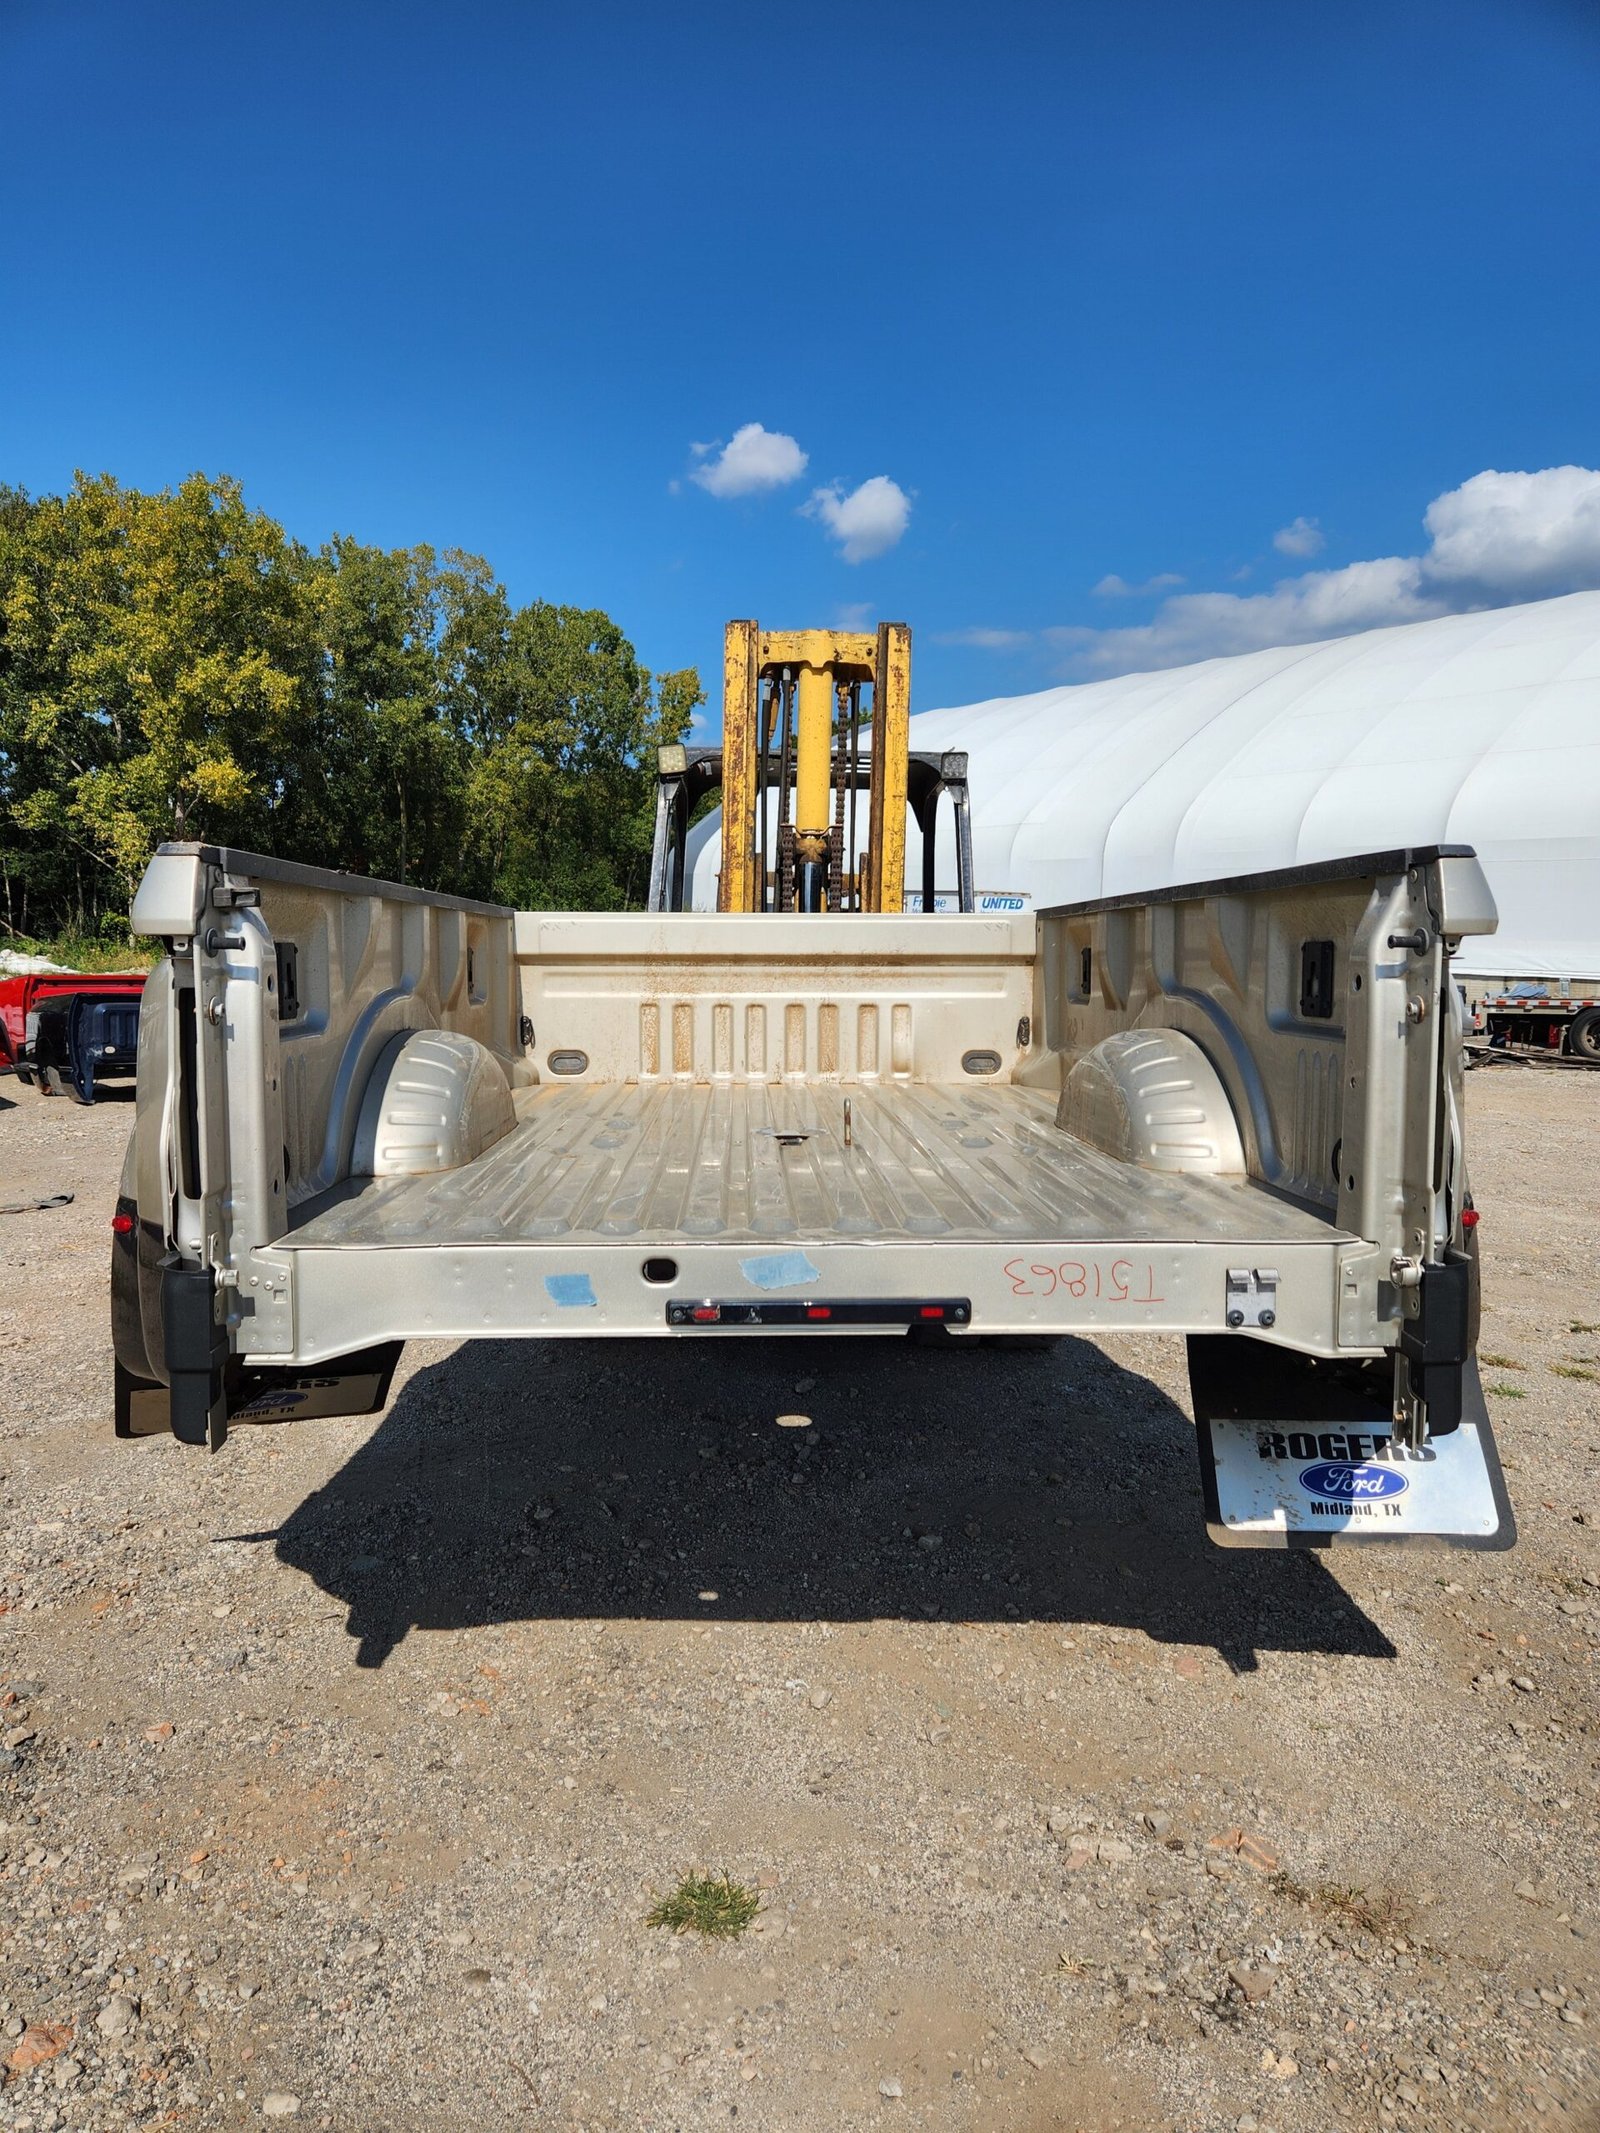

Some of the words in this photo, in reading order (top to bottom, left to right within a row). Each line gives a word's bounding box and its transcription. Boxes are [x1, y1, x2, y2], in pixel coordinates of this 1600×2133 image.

[982, 897, 1024, 910] UNITED
[1004, 1259, 1165, 1302] T51863
[280, 1406, 295, 1414] TX
[1323, 1466, 1385, 1494] Ford
[1310, 1501, 1378, 1517] Midland,
[1382, 1503, 1402, 1516] TX
